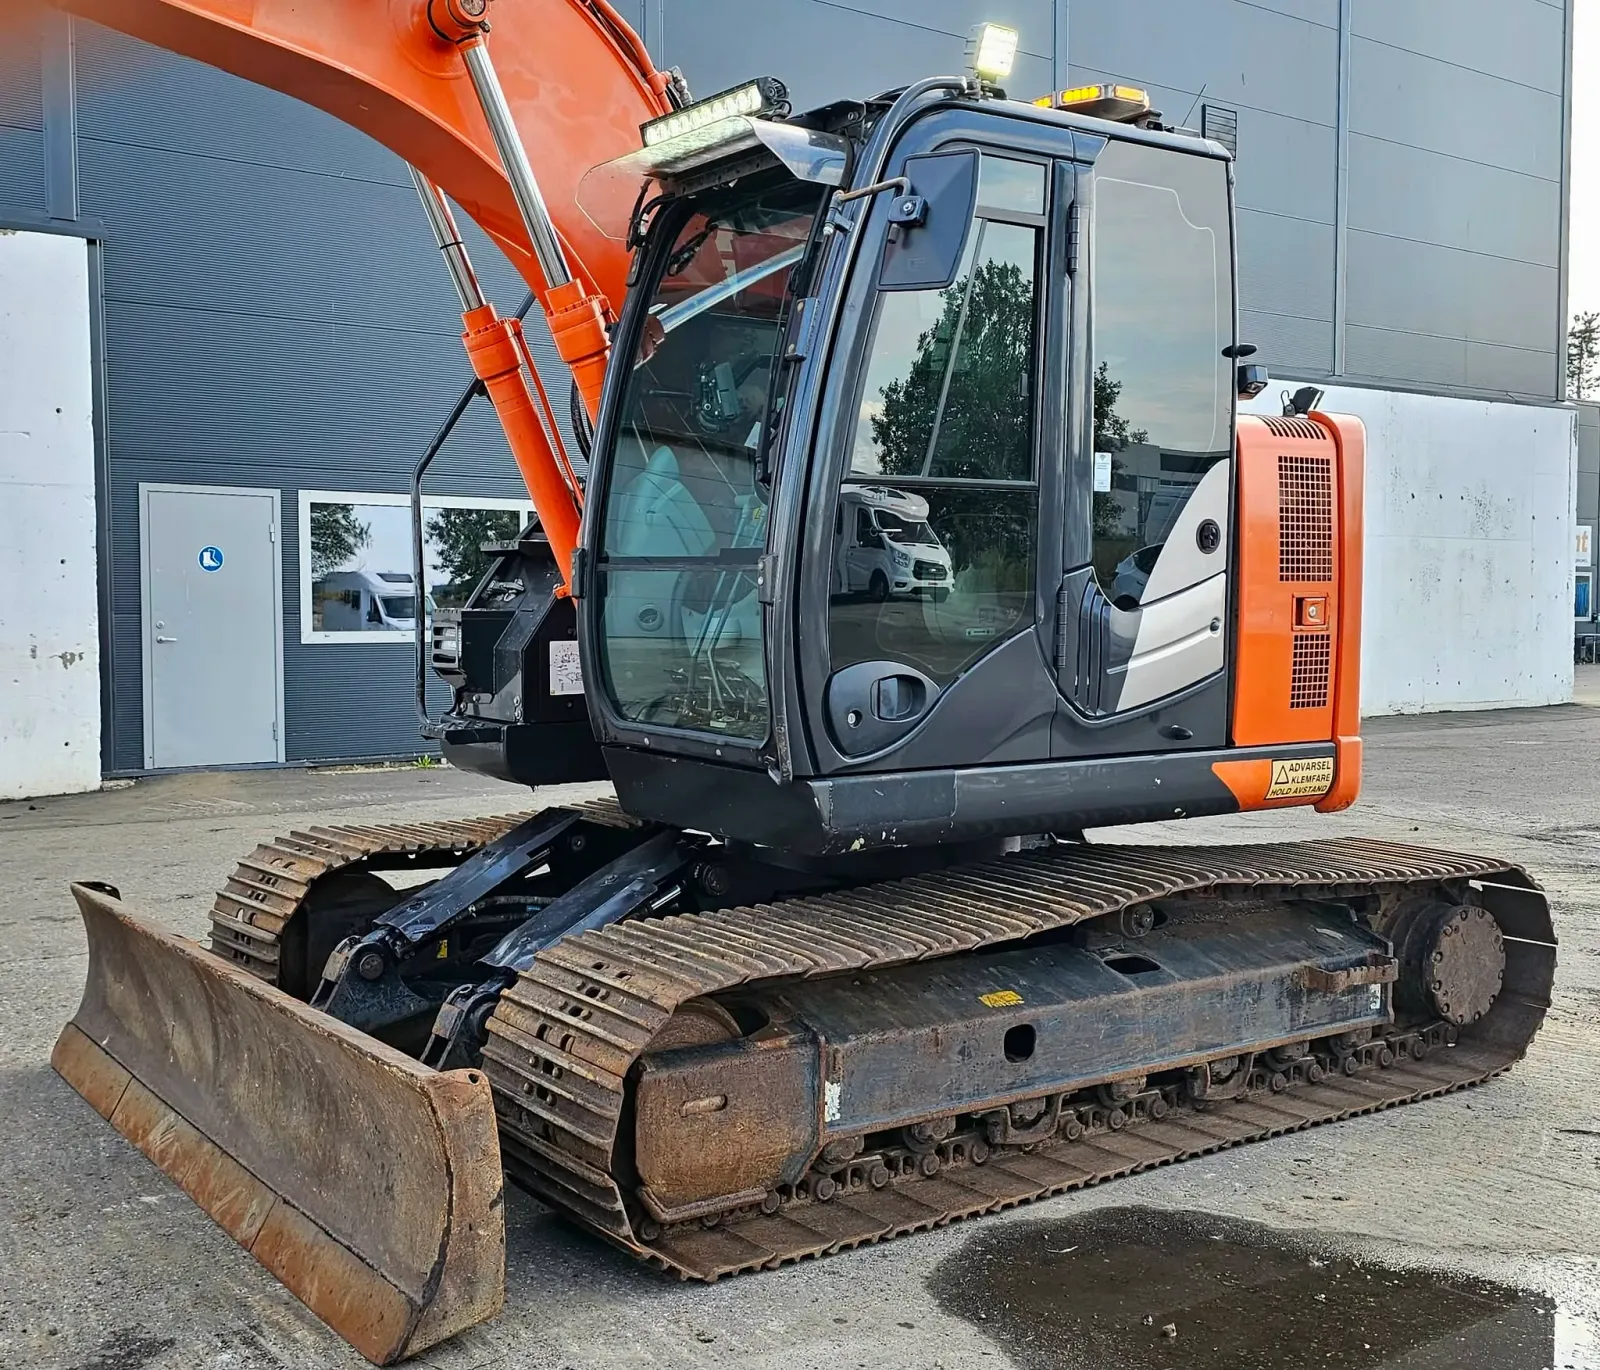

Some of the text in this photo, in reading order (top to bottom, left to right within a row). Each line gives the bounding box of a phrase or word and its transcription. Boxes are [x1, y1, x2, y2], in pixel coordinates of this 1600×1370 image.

[1289, 761, 1331, 772] ADVARSEL
[1291, 774, 1330, 784] KLEMFARE
[1270, 785, 1327, 796] HOLD AVSTAND
